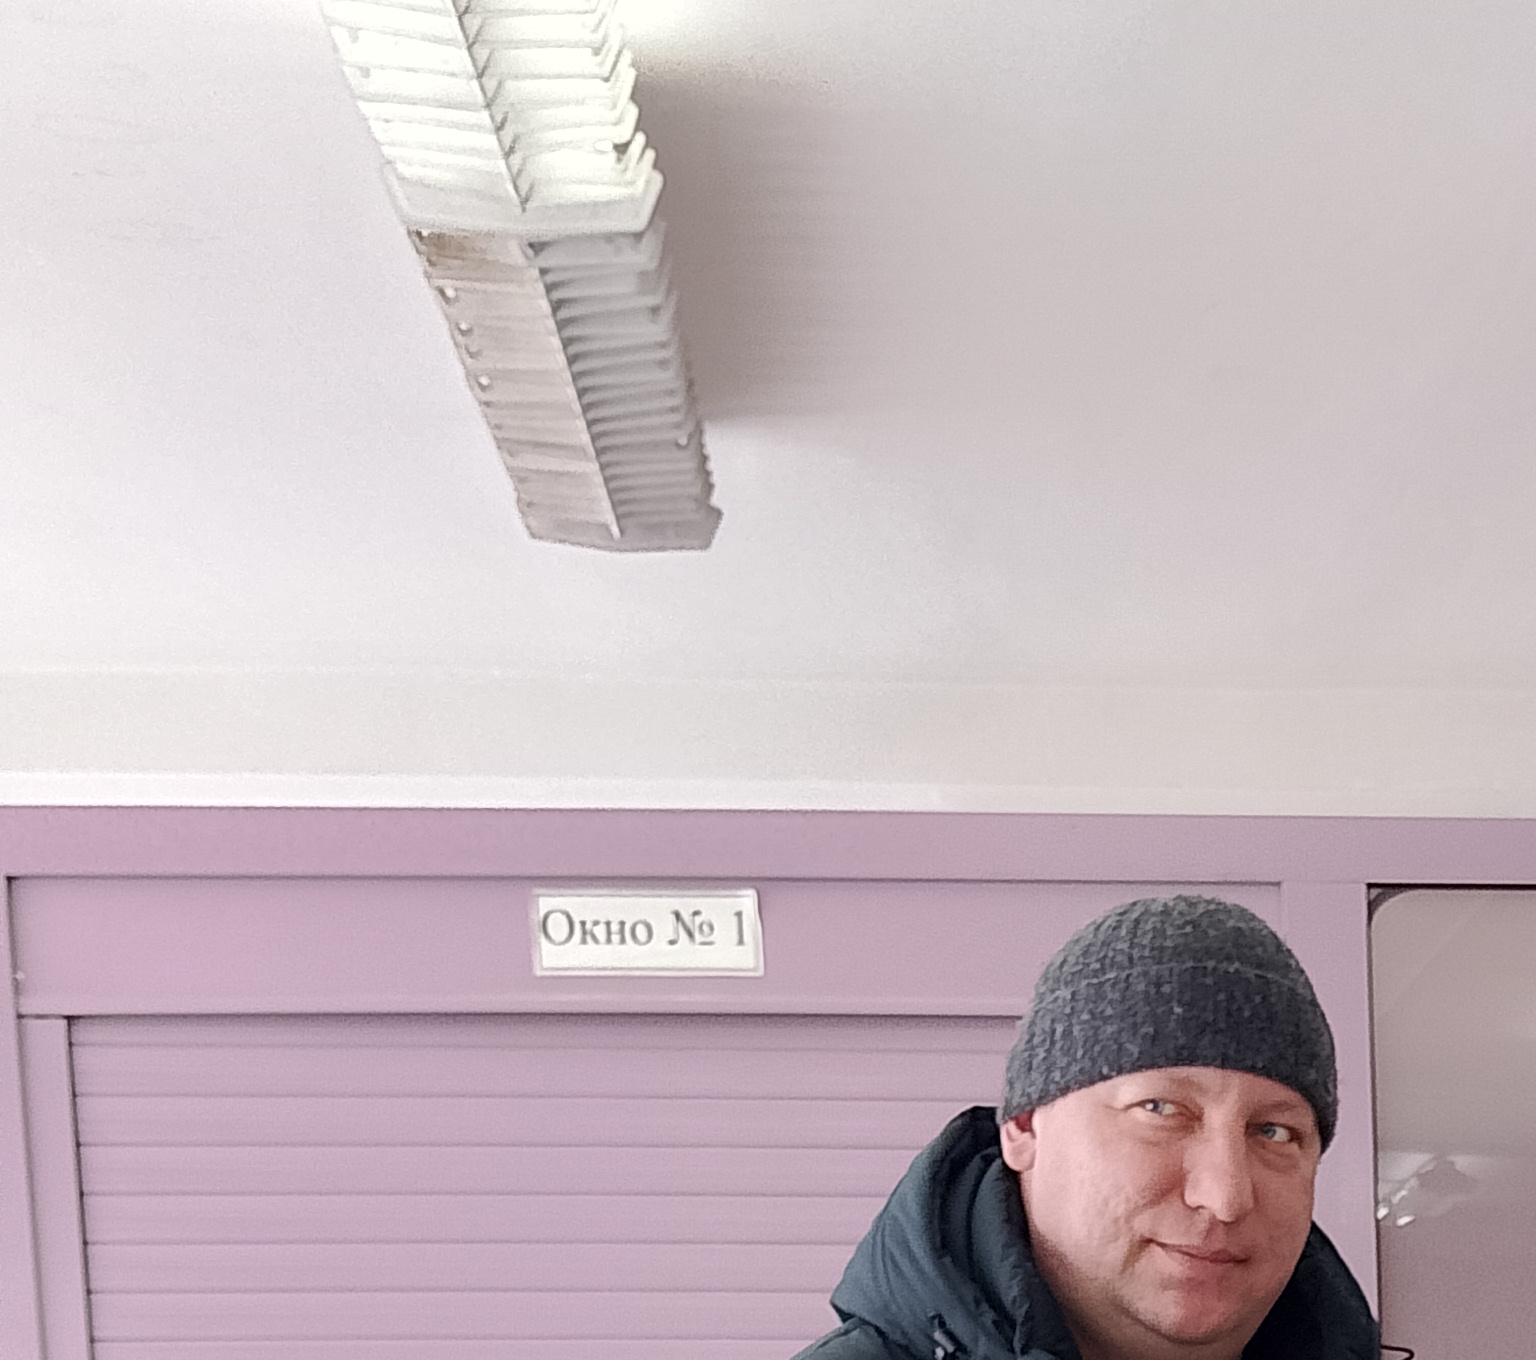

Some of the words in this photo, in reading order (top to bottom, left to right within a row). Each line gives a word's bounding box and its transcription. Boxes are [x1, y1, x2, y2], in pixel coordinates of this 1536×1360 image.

[541, 908, 654, 946] Окно
[667, 909, 716, 946] №
[733, 910, 746, 946] 1
